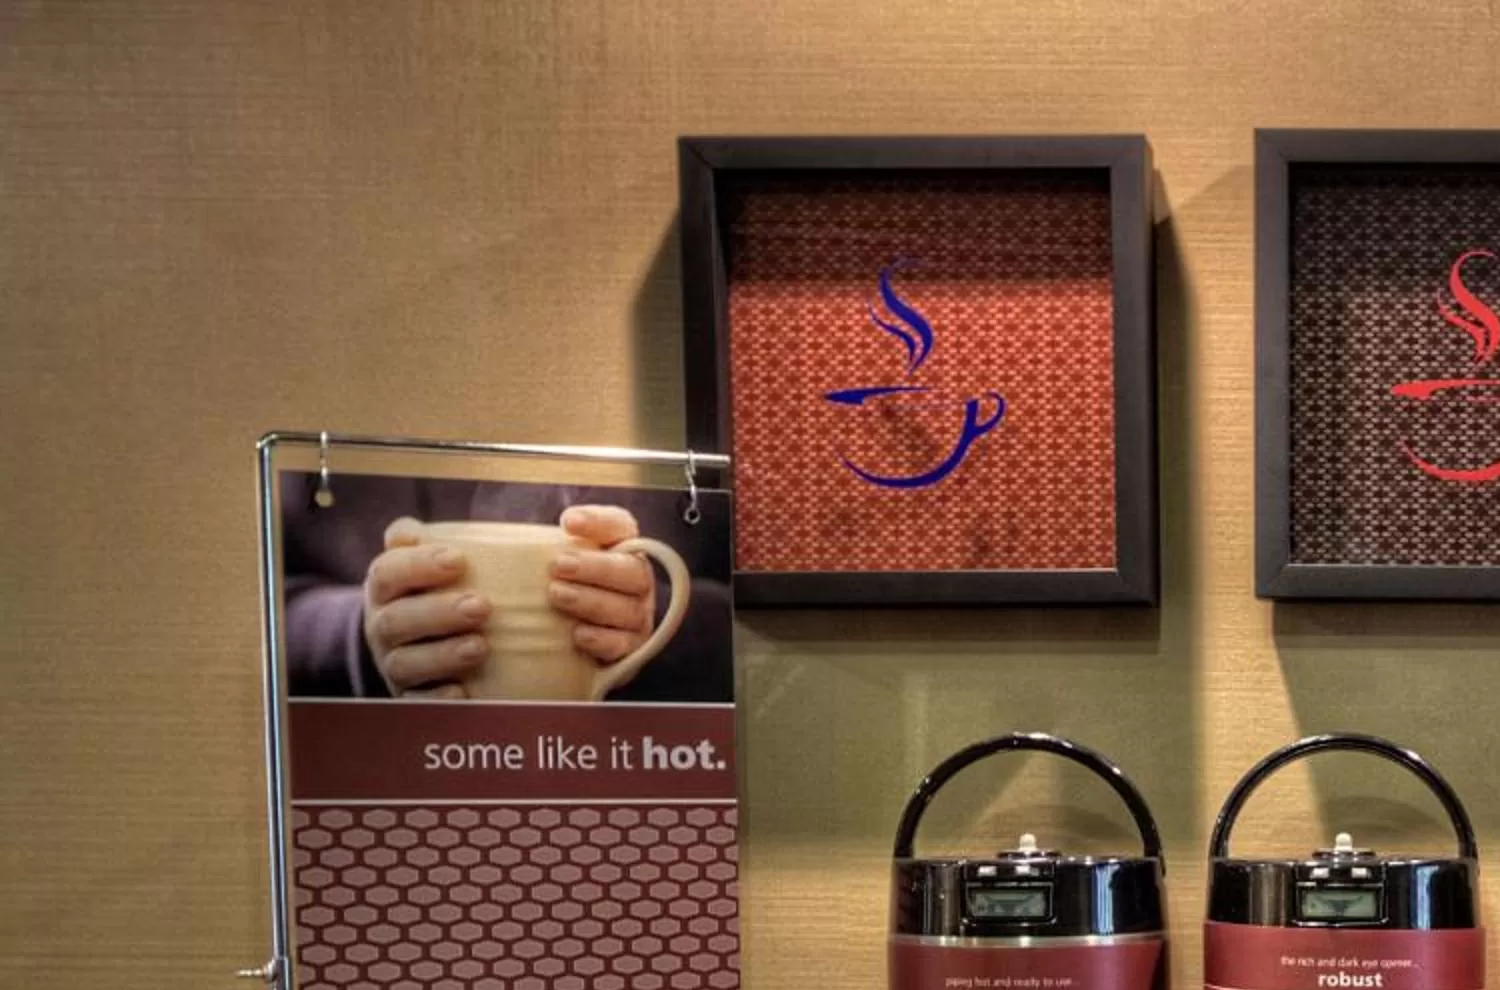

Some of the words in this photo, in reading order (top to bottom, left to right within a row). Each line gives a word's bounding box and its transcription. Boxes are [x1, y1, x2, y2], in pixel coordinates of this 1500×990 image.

[424, 743, 525, 769] some
[537, 736, 598, 769] like
[610, 736, 634, 769] it
[643, 736, 727, 770] hot.
[1281, 956, 1296, 966] the
[1298, 956, 1315, 967] rich
[1317, 957, 1336, 967] and
[1338, 956, 1359, 967] dark
[994, 976, 1011, 987] and
[1318, 971, 1384, 988] robust
